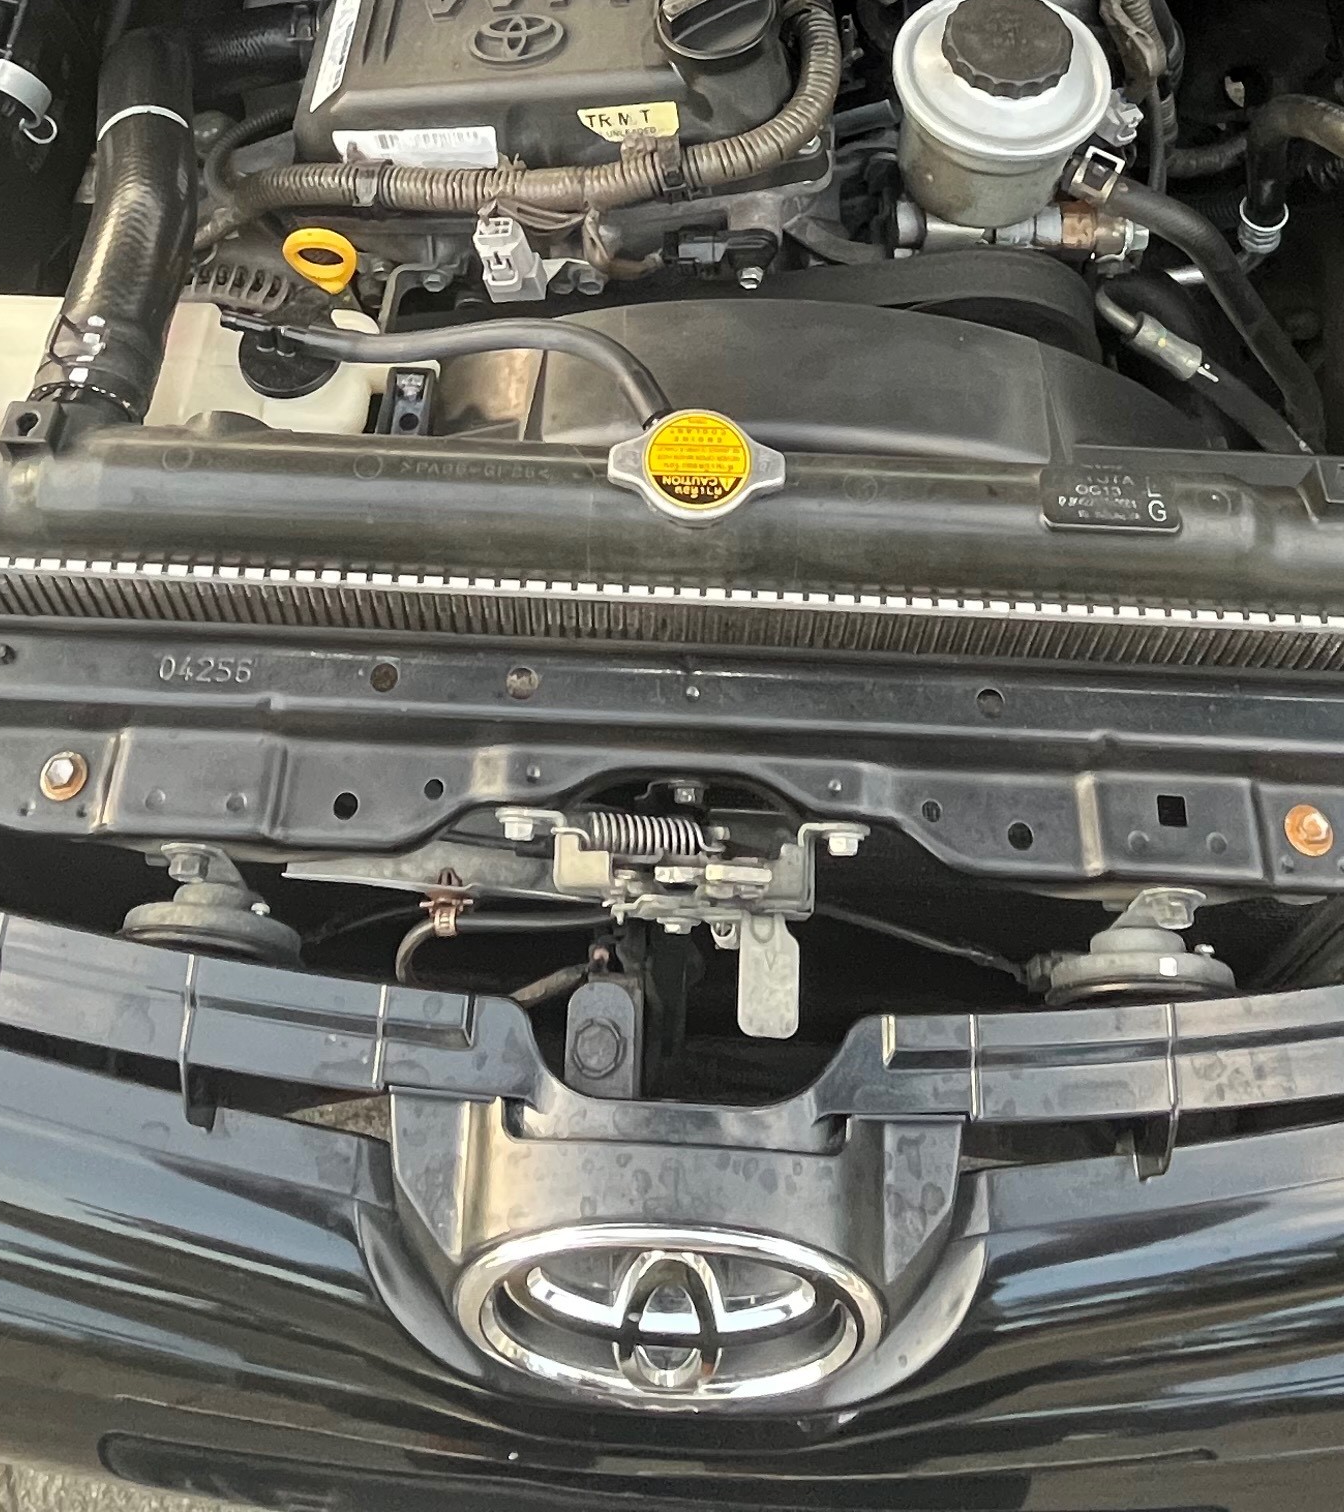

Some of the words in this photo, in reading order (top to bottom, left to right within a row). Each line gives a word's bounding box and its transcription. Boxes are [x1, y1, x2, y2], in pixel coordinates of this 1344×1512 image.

[662, 475, 718, 485] CAUTION
[1148, 499, 1168, 522] G
[159, 654, 253, 683] 04256
